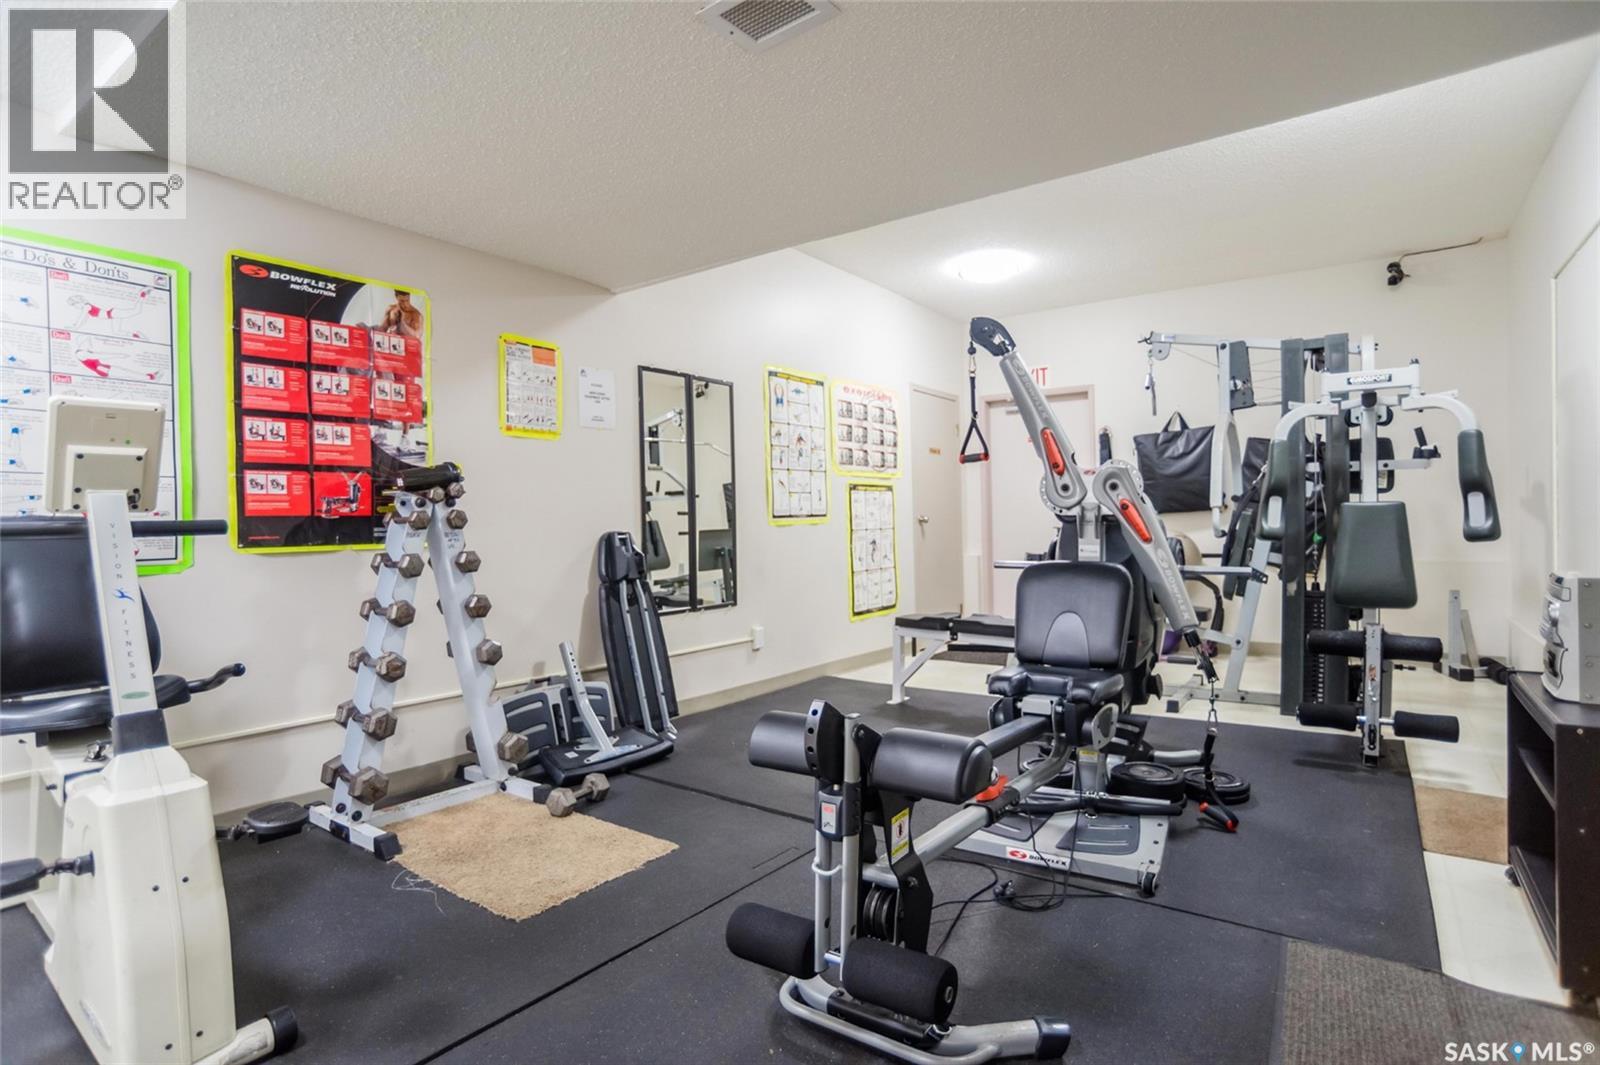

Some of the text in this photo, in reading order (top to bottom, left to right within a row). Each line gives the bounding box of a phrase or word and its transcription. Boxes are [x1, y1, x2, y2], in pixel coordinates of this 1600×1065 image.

[62, 258, 77, 270] &
[270, 271, 337, 291] BOWFLEX
[109, 522, 123, 579] VISION
[122, 609, 136, 679] FITNESS
